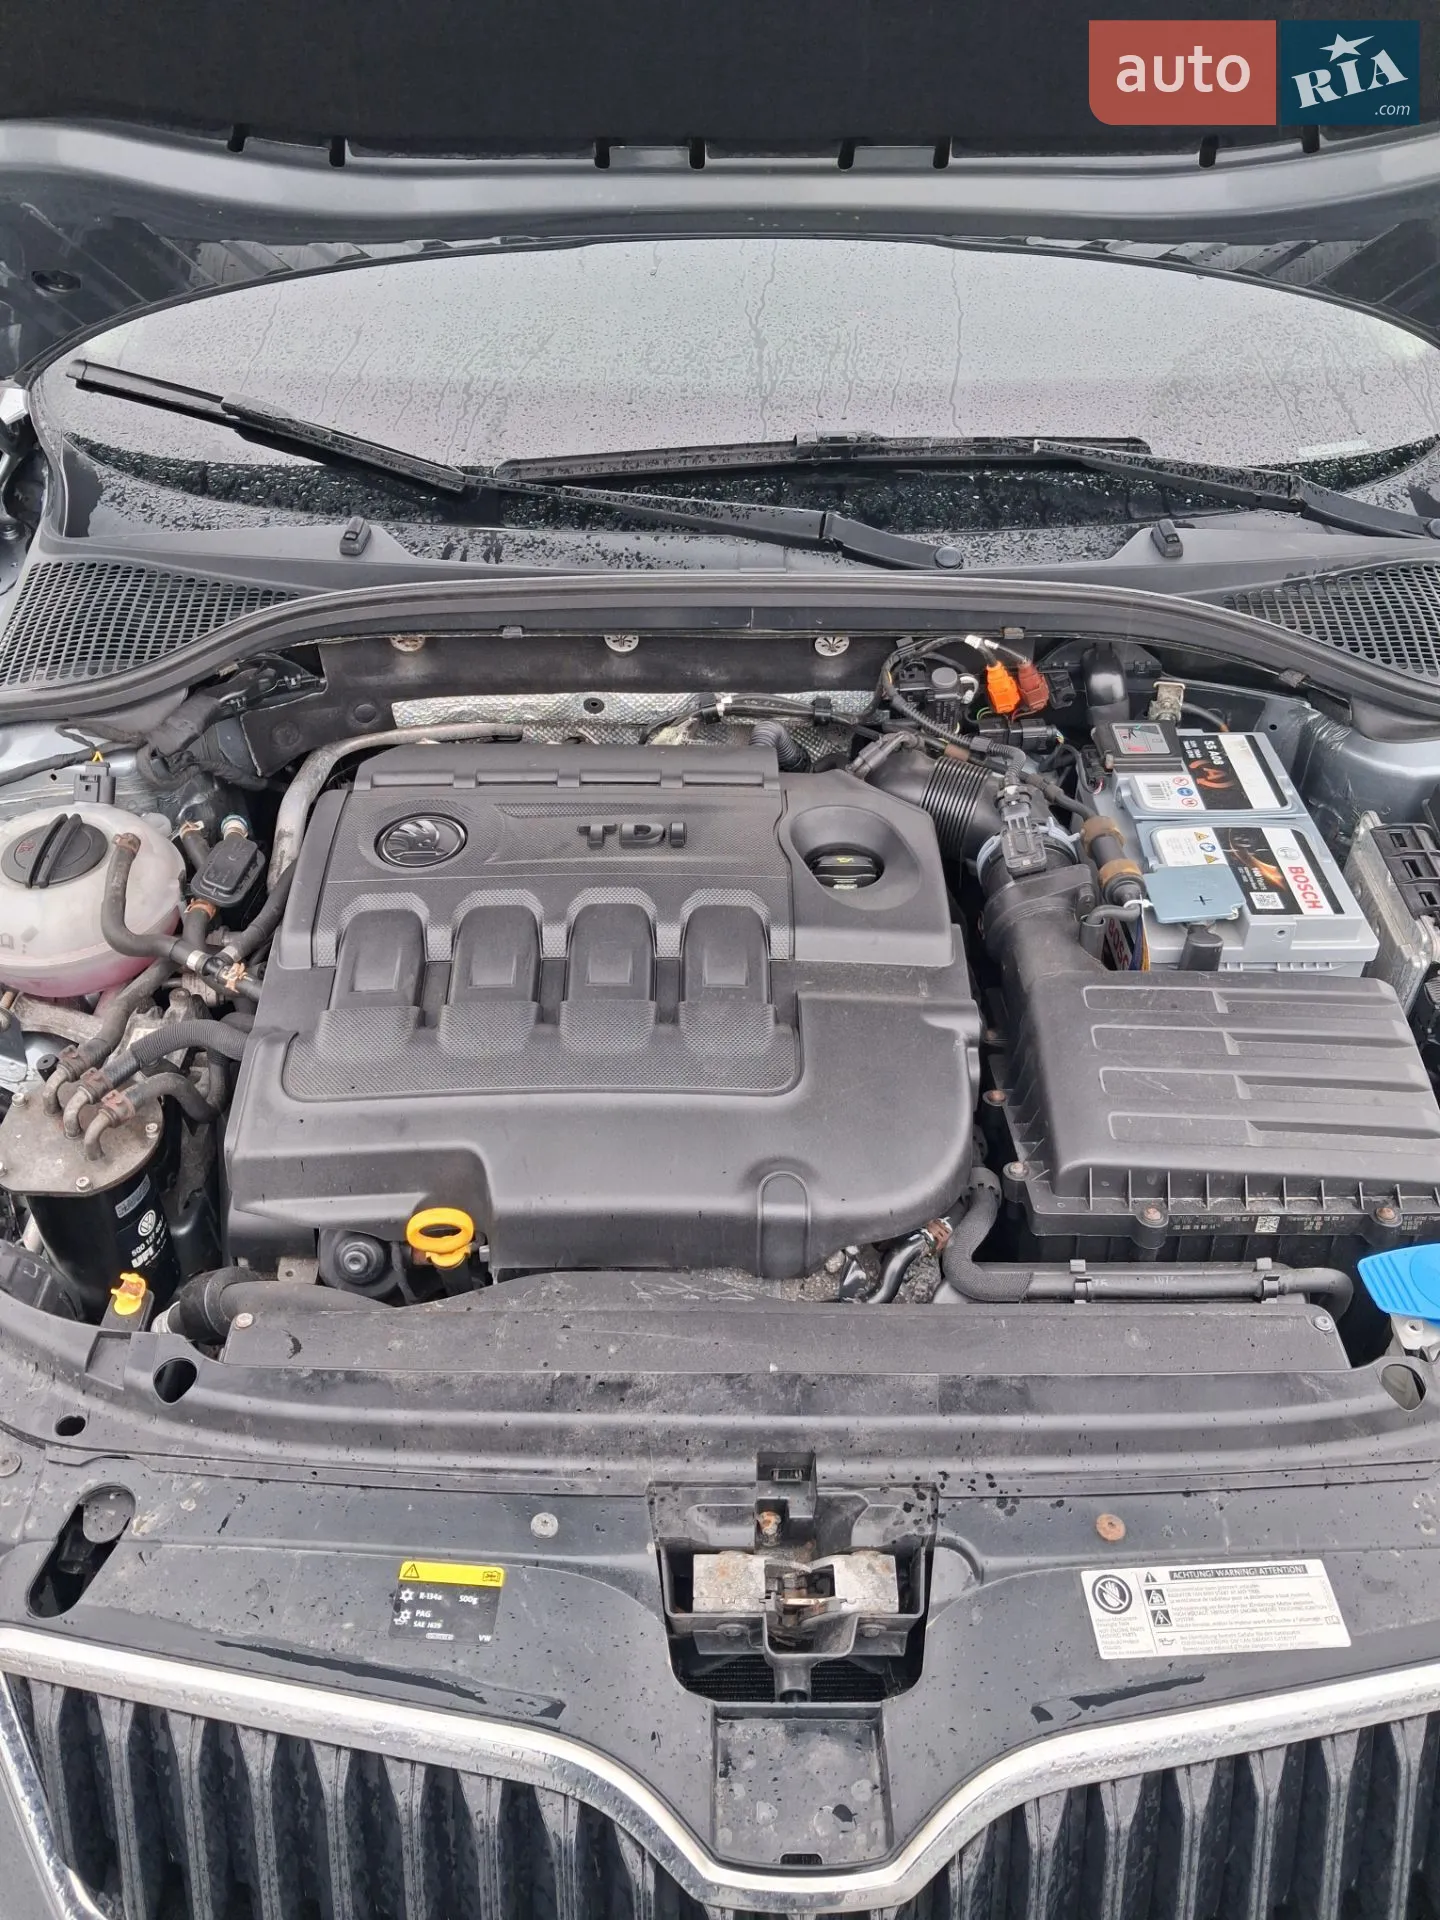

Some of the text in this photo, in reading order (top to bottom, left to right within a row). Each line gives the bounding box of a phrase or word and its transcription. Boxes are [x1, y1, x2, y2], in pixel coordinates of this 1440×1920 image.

[576, 821, 688, 848] TDI
[1288, 866, 1323, 909] BOSCH
[1173, 1564, 1306, 1579] ACHTUNG! WARNING! ATTENTION!
[415, 1609, 432, 1618] PAG
[413, 1620, 426, 1628] SAE
[478, 1634, 492, 1643] VW
